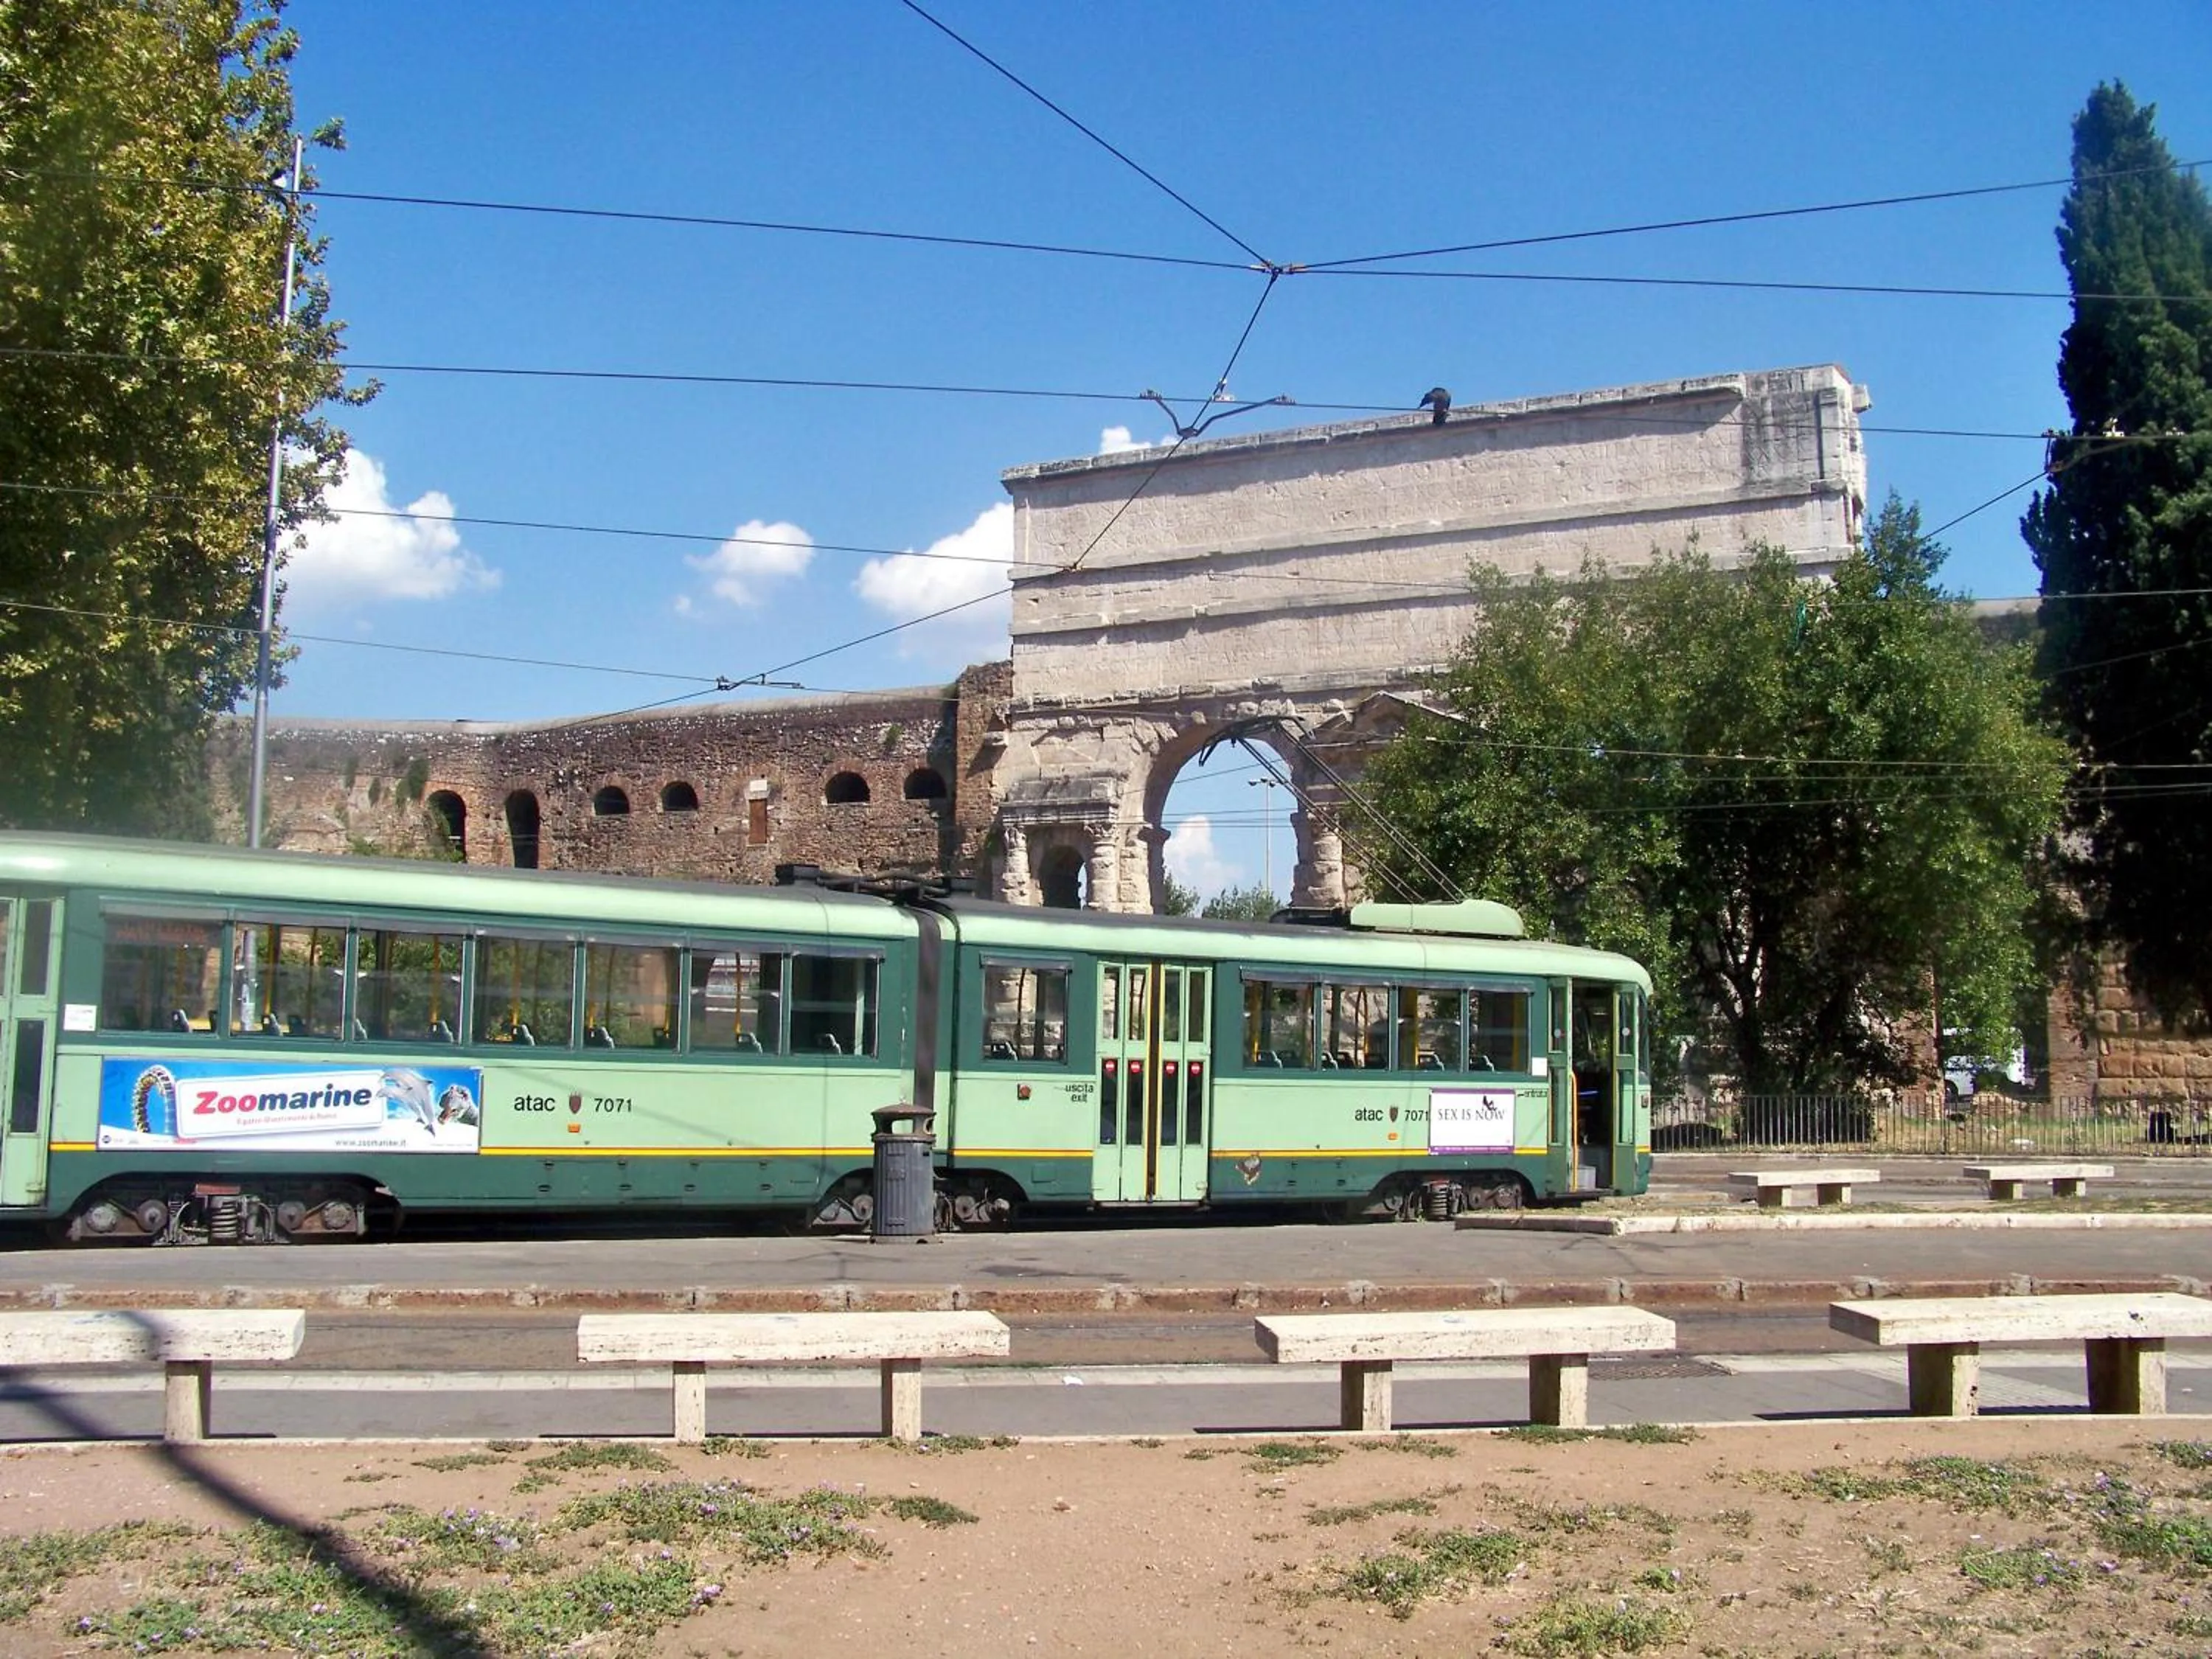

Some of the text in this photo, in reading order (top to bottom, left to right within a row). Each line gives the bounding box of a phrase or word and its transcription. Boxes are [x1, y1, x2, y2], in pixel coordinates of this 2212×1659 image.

[1065, 1084, 1093, 1093] uscita
[193, 1083, 372, 1115] Zoomarine
[514, 1094, 632, 1113] atac 7071
[1071, 1093, 1088, 1103] exit
[1354, 1107, 1429, 1121] atac 7071
[1438, 1107, 1505, 1121] SEX IS NOW
